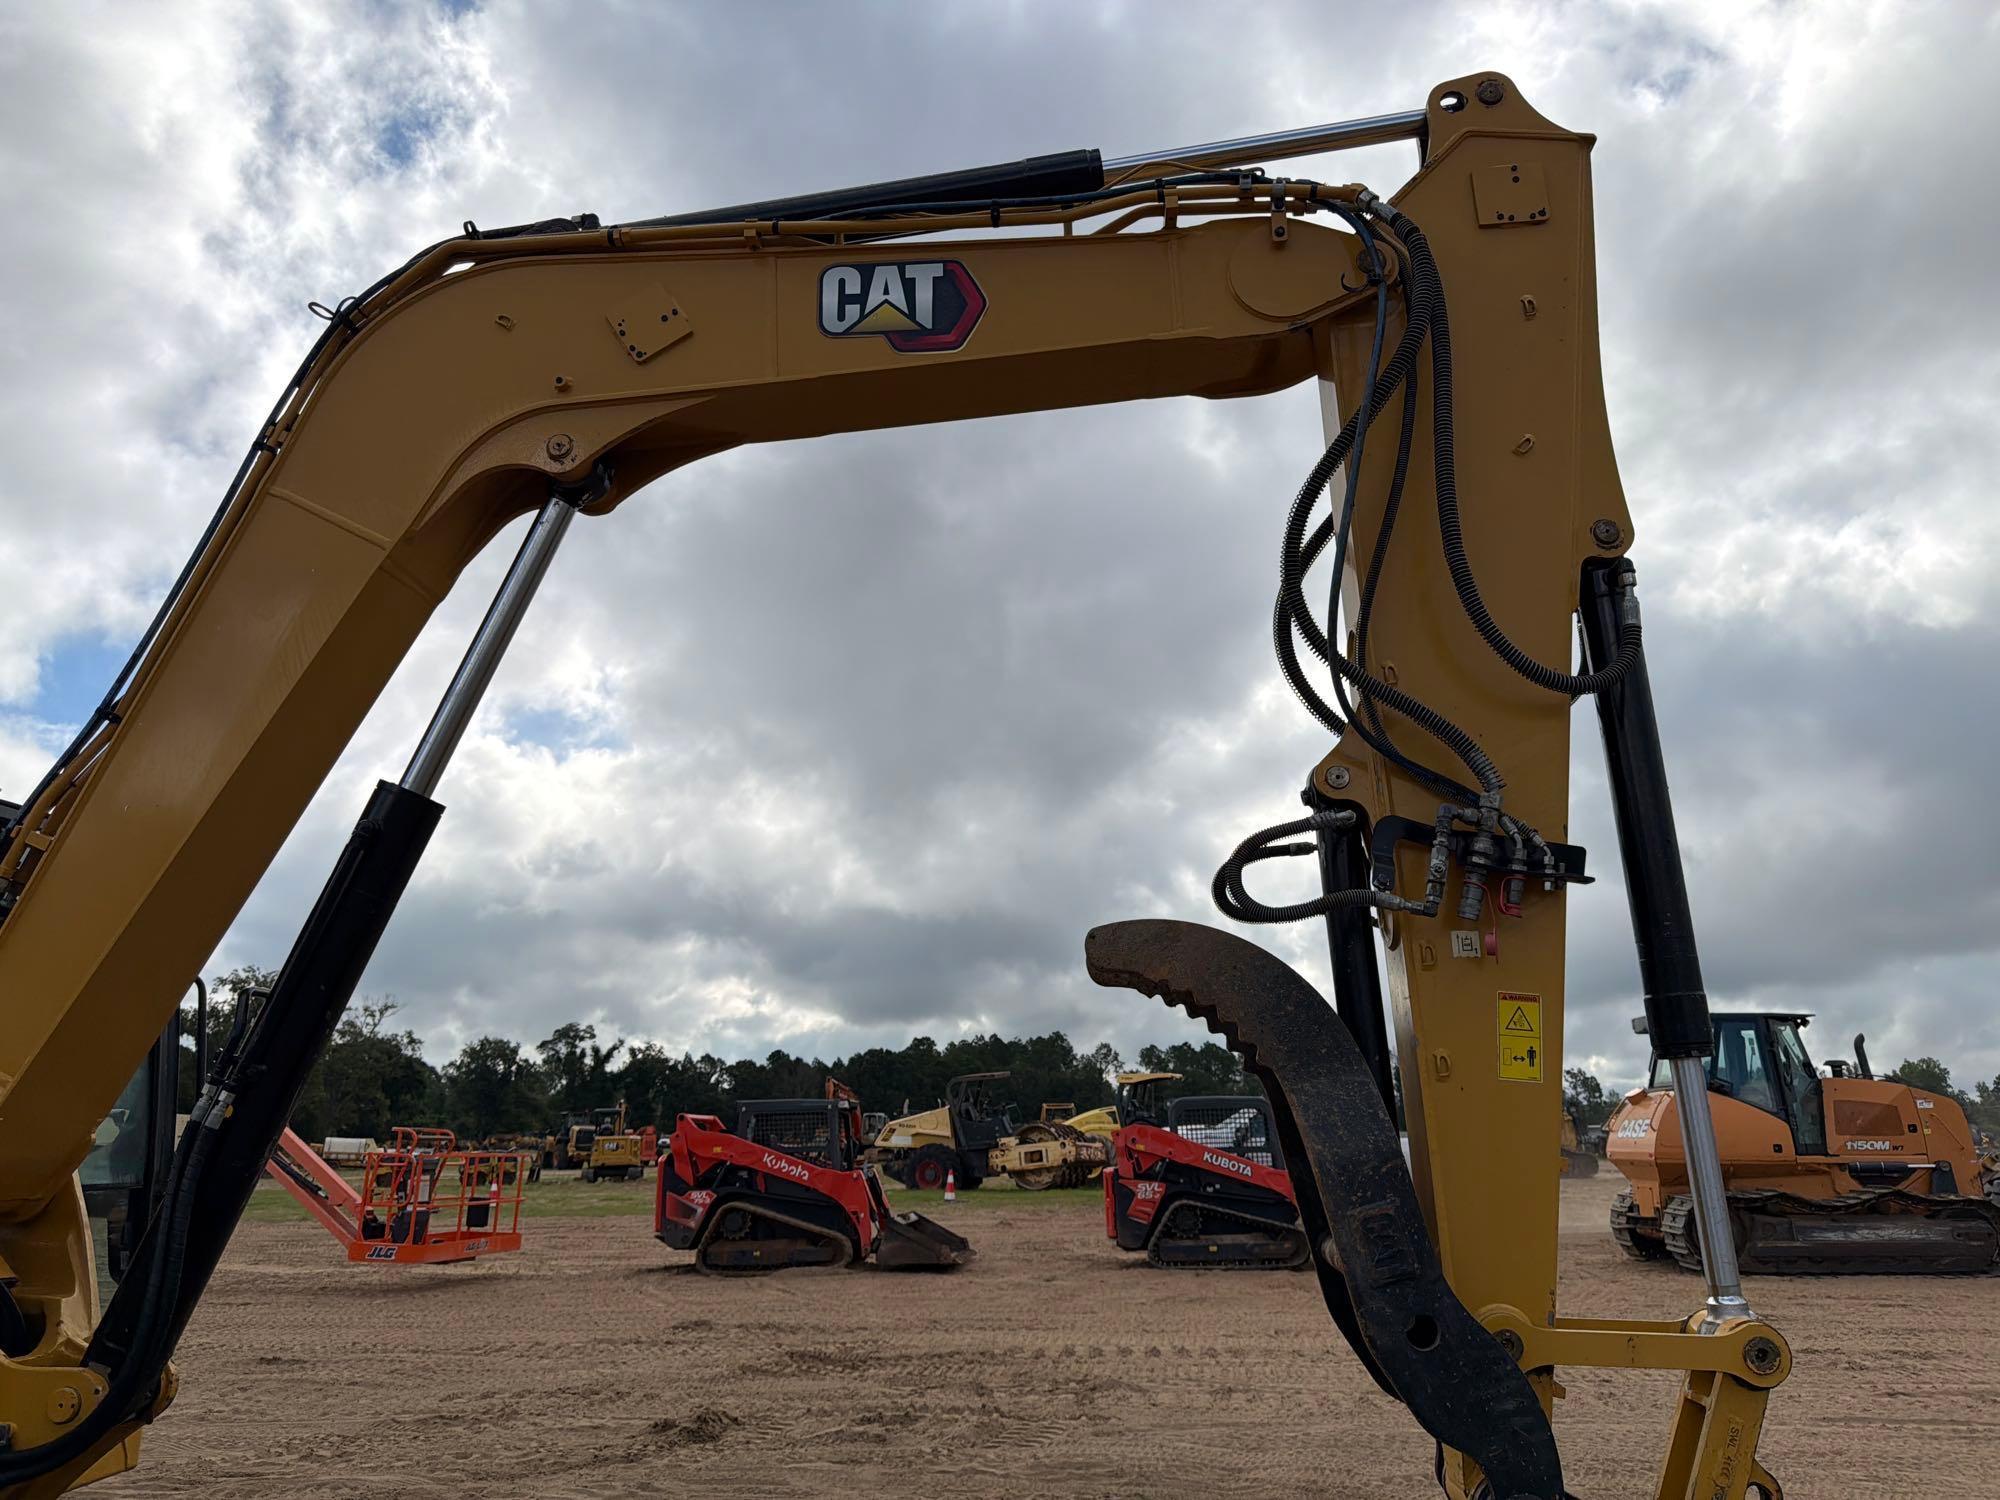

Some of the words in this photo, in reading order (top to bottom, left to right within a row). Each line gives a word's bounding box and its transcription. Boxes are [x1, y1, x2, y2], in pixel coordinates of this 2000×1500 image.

[822, 263, 944, 334] CAT
[1508, 994, 1538, 1003] WARNING
[1617, 1119, 1651, 1138] CASE
[1845, 1140, 1890, 1152] 1150M
[762, 1152, 809, 1180] Kubota
[1203, 1151, 1252, 1177] KUBOTA
[1136, 1182, 1163, 1192] SVL
[366, 1246, 396, 1259] JLG
[1727, 1426, 1740, 1449] SWL
